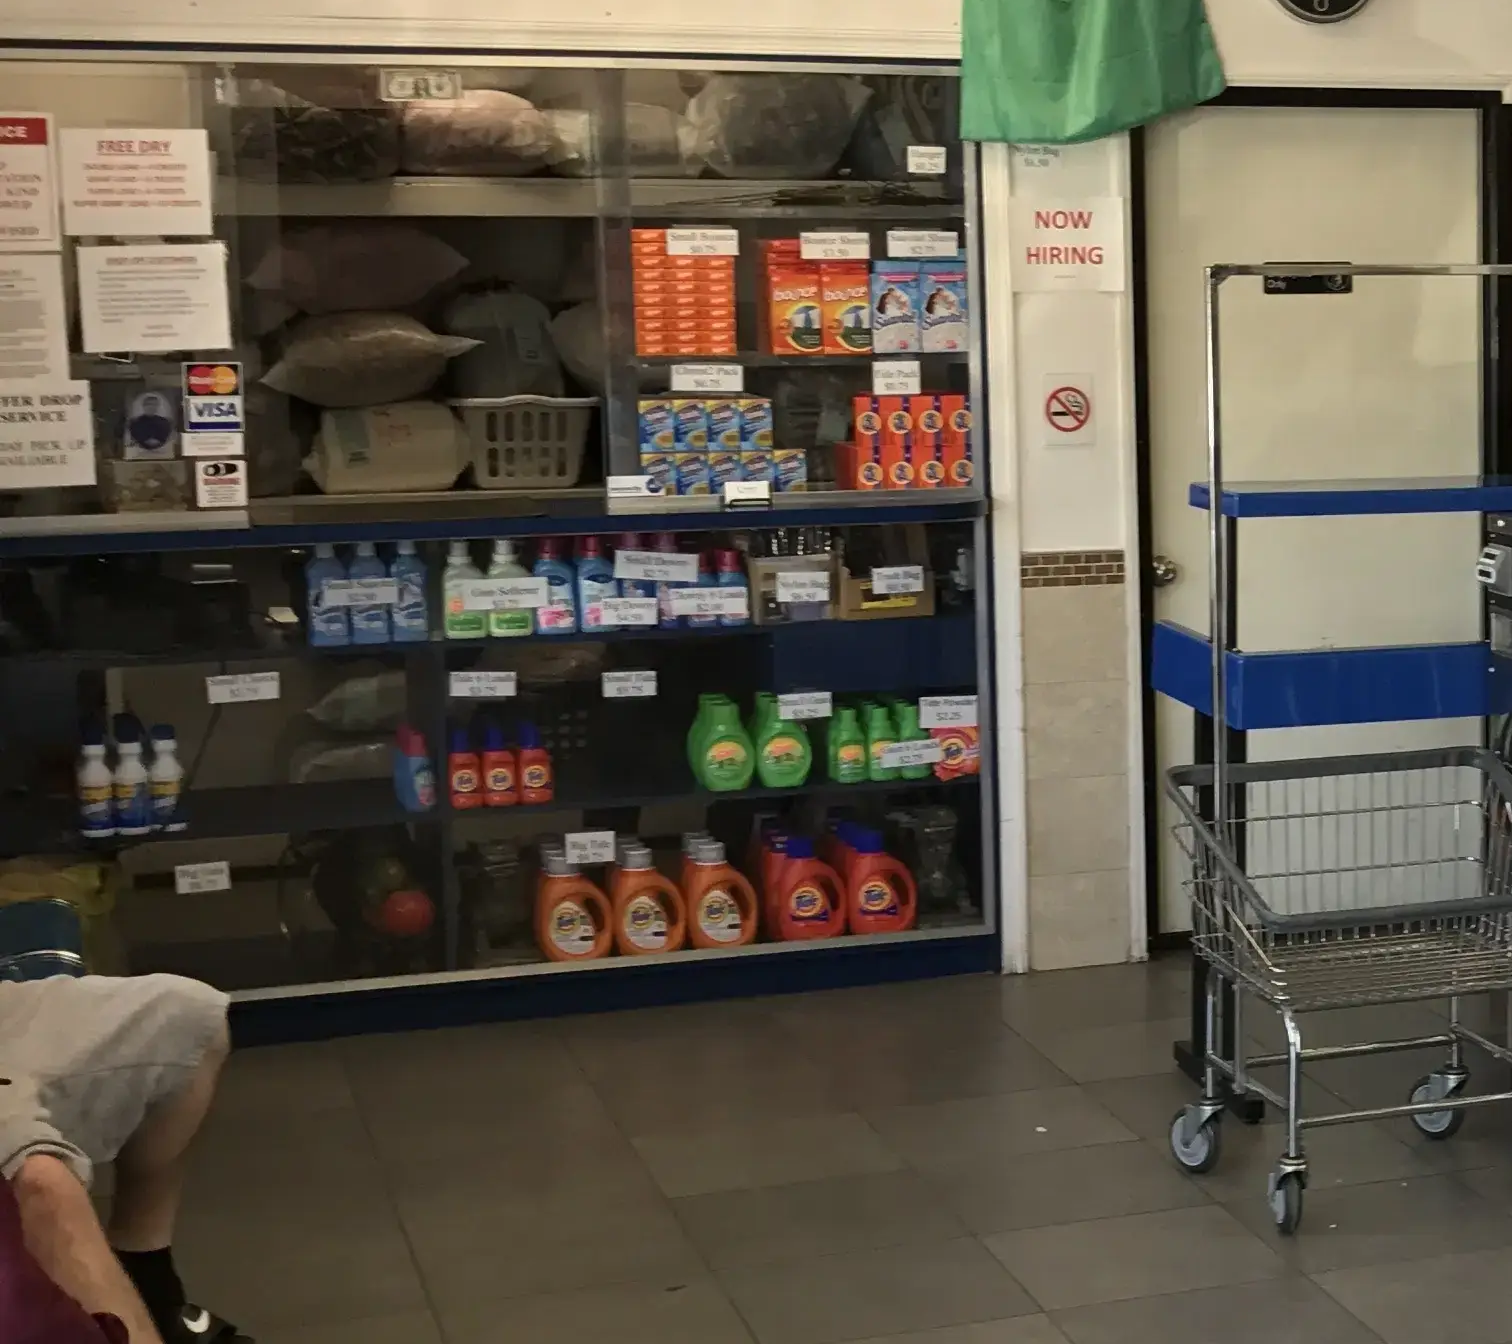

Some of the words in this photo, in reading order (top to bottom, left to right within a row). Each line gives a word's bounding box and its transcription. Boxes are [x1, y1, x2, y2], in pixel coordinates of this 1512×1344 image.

[97, 140, 134, 153] FREE
[138, 140, 172, 153] DRY
[1035, 210, 1093, 230] NOW
[1025, 246, 1104, 265] HIRING
[41, 394, 84, 407] DROP
[194, 401, 239, 419] VISA
